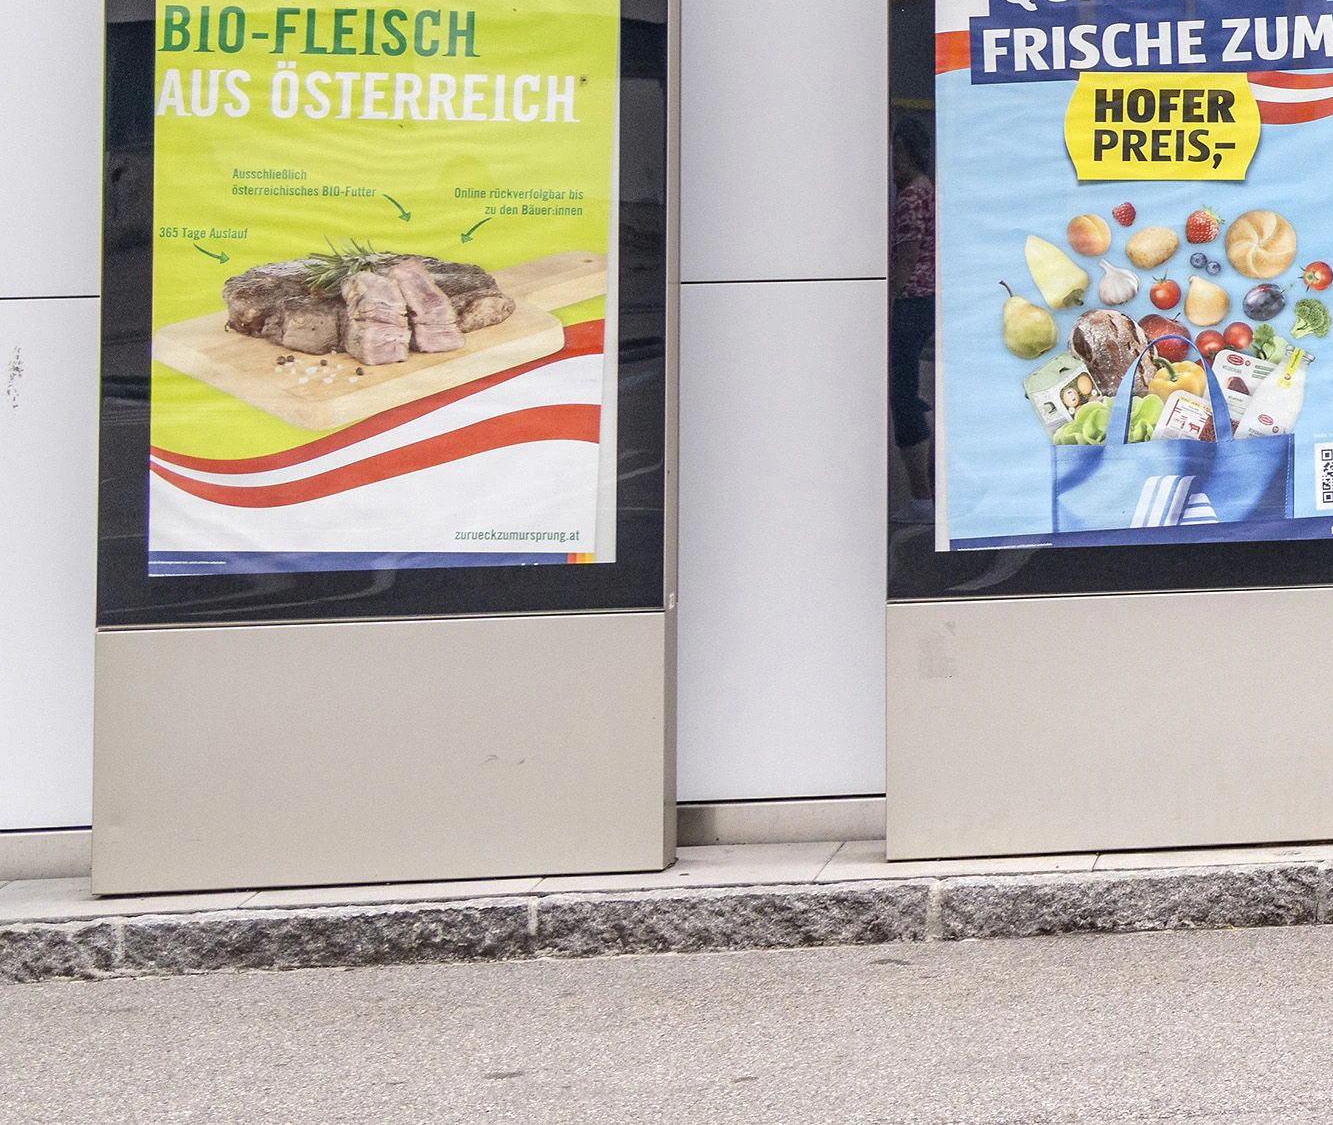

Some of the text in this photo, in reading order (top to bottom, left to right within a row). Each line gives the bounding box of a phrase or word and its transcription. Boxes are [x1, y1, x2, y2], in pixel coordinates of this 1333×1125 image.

[158, 4, 480, 58] BIO-FLEISCH
[982, 18, 1205, 75] FRISCHE
[155, 60, 581, 123] AUS ÖSTERREICH
[1093, 88, 1237, 124] HOFER
[1093, 128, 1236, 170] PREIS,-
[232, 168, 307, 181] Ausschließlich
[232, 184, 377, 198] österreichisches BIO-Futter
[454, 187, 584, 202] Online rückverfolgbar bis
[484, 204, 583, 216] zu den Bäuer:innen
[159, 227, 248, 240] 365 Tage Auslauf
[455, 529, 580, 542] zurueckzumursprung.at
